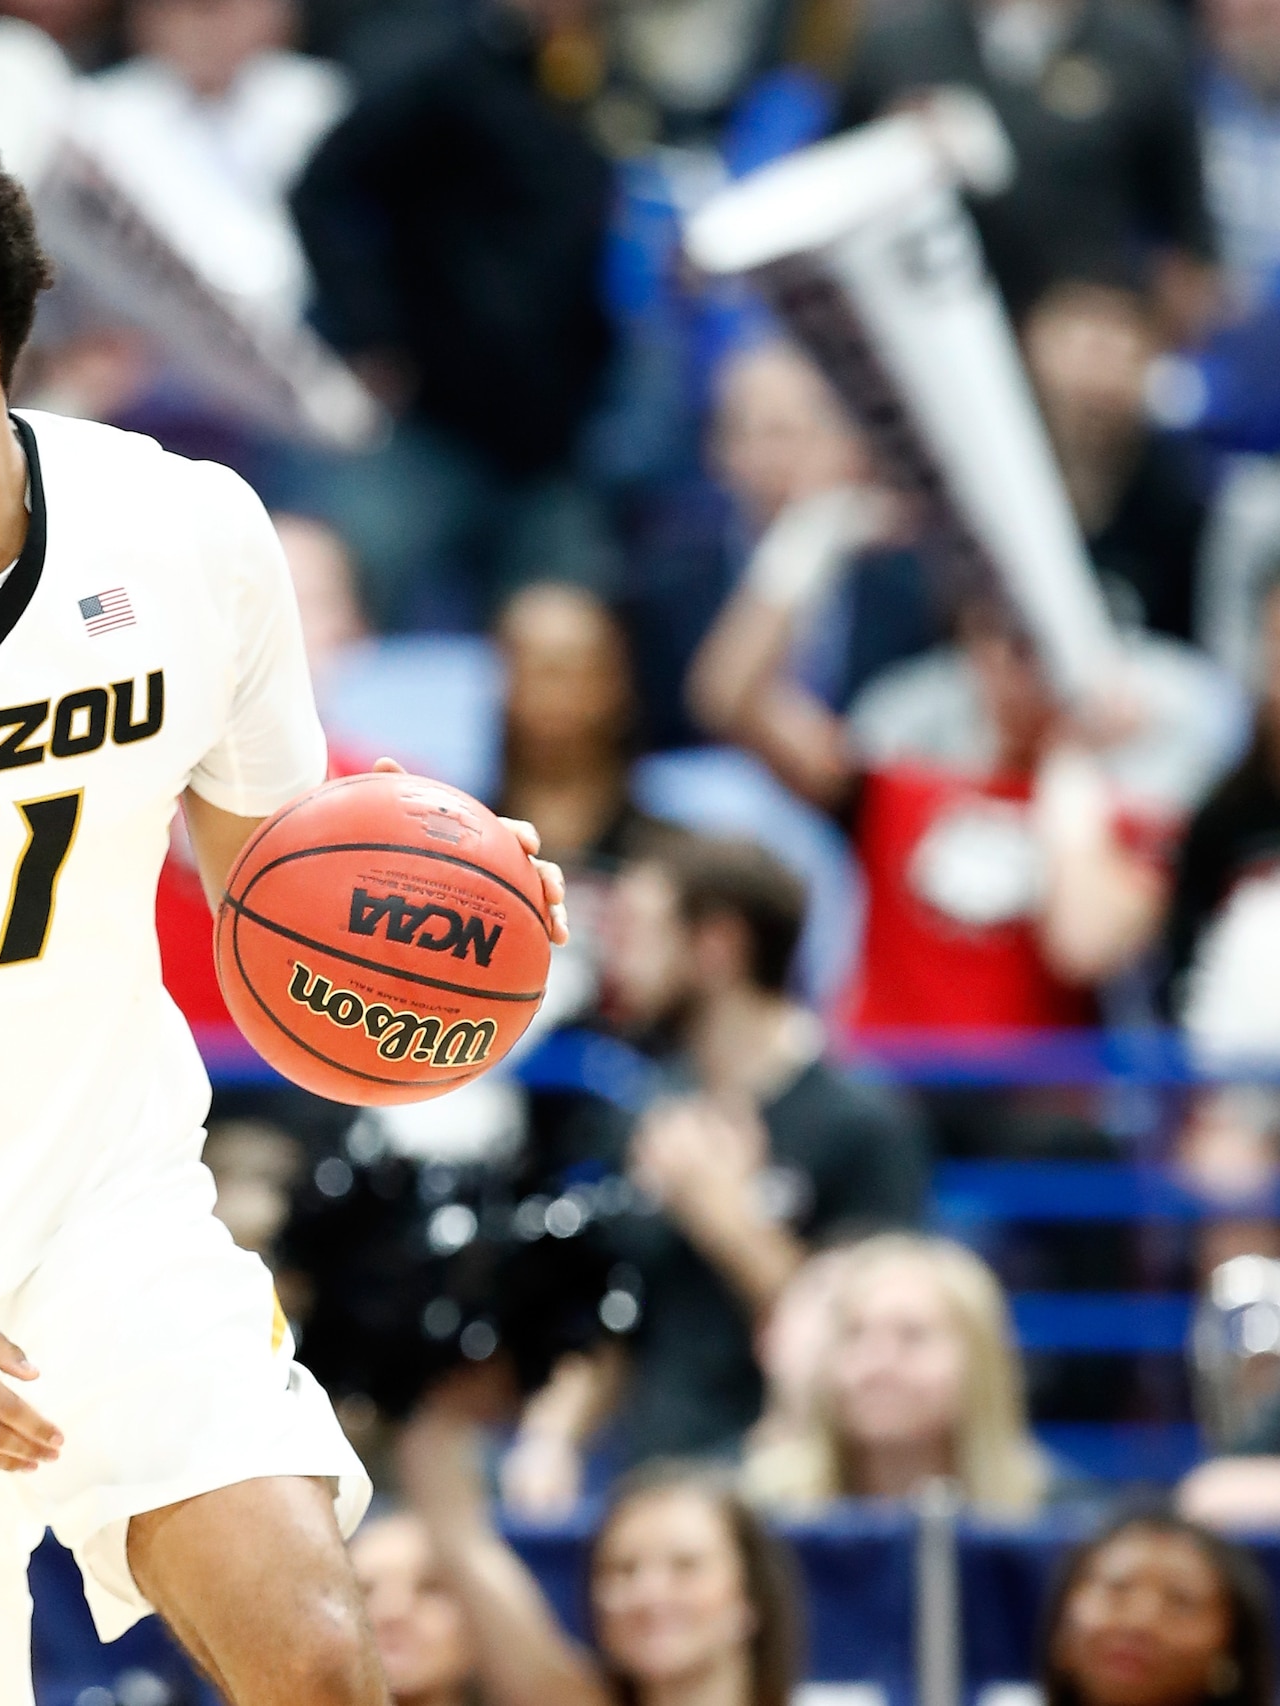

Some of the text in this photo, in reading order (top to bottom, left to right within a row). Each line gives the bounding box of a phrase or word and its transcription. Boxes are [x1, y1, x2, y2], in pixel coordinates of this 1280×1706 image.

[356, 874, 399, 890] BALL
[402, 882, 446, 901] GAME
[348, 887, 503, 968] NCAA
[287, 960, 498, 1068] Wilson
